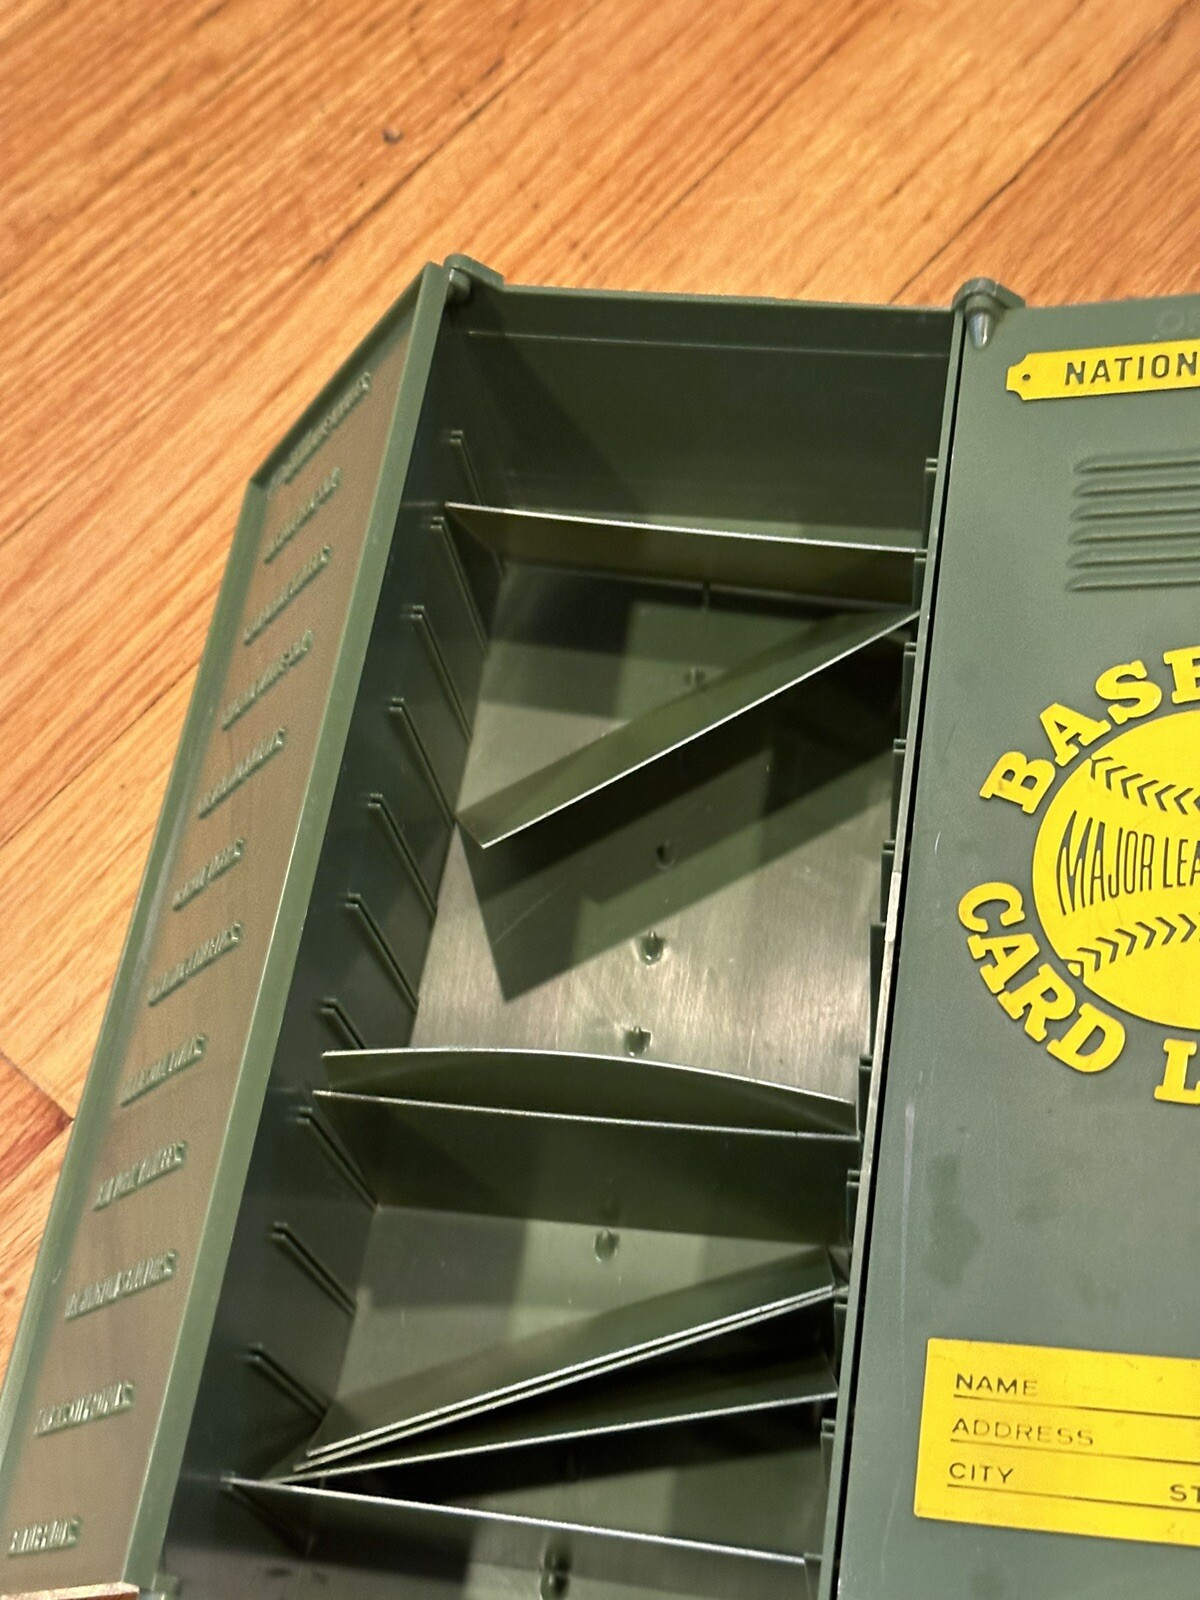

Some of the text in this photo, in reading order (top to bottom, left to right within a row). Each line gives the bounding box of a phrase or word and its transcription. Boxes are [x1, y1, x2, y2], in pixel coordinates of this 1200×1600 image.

[1064, 351, 1198, 386] NATION
[979, 645, 1200, 815] BASE
[1056, 809, 1155, 916] MAJOR
[958, 881, 1126, 1074] CARD
[955, 1372, 1038, 1397] NAME
[952, 1417, 1094, 1446] ADDRESS
[949, 1461, 1014, 1484] CITY
